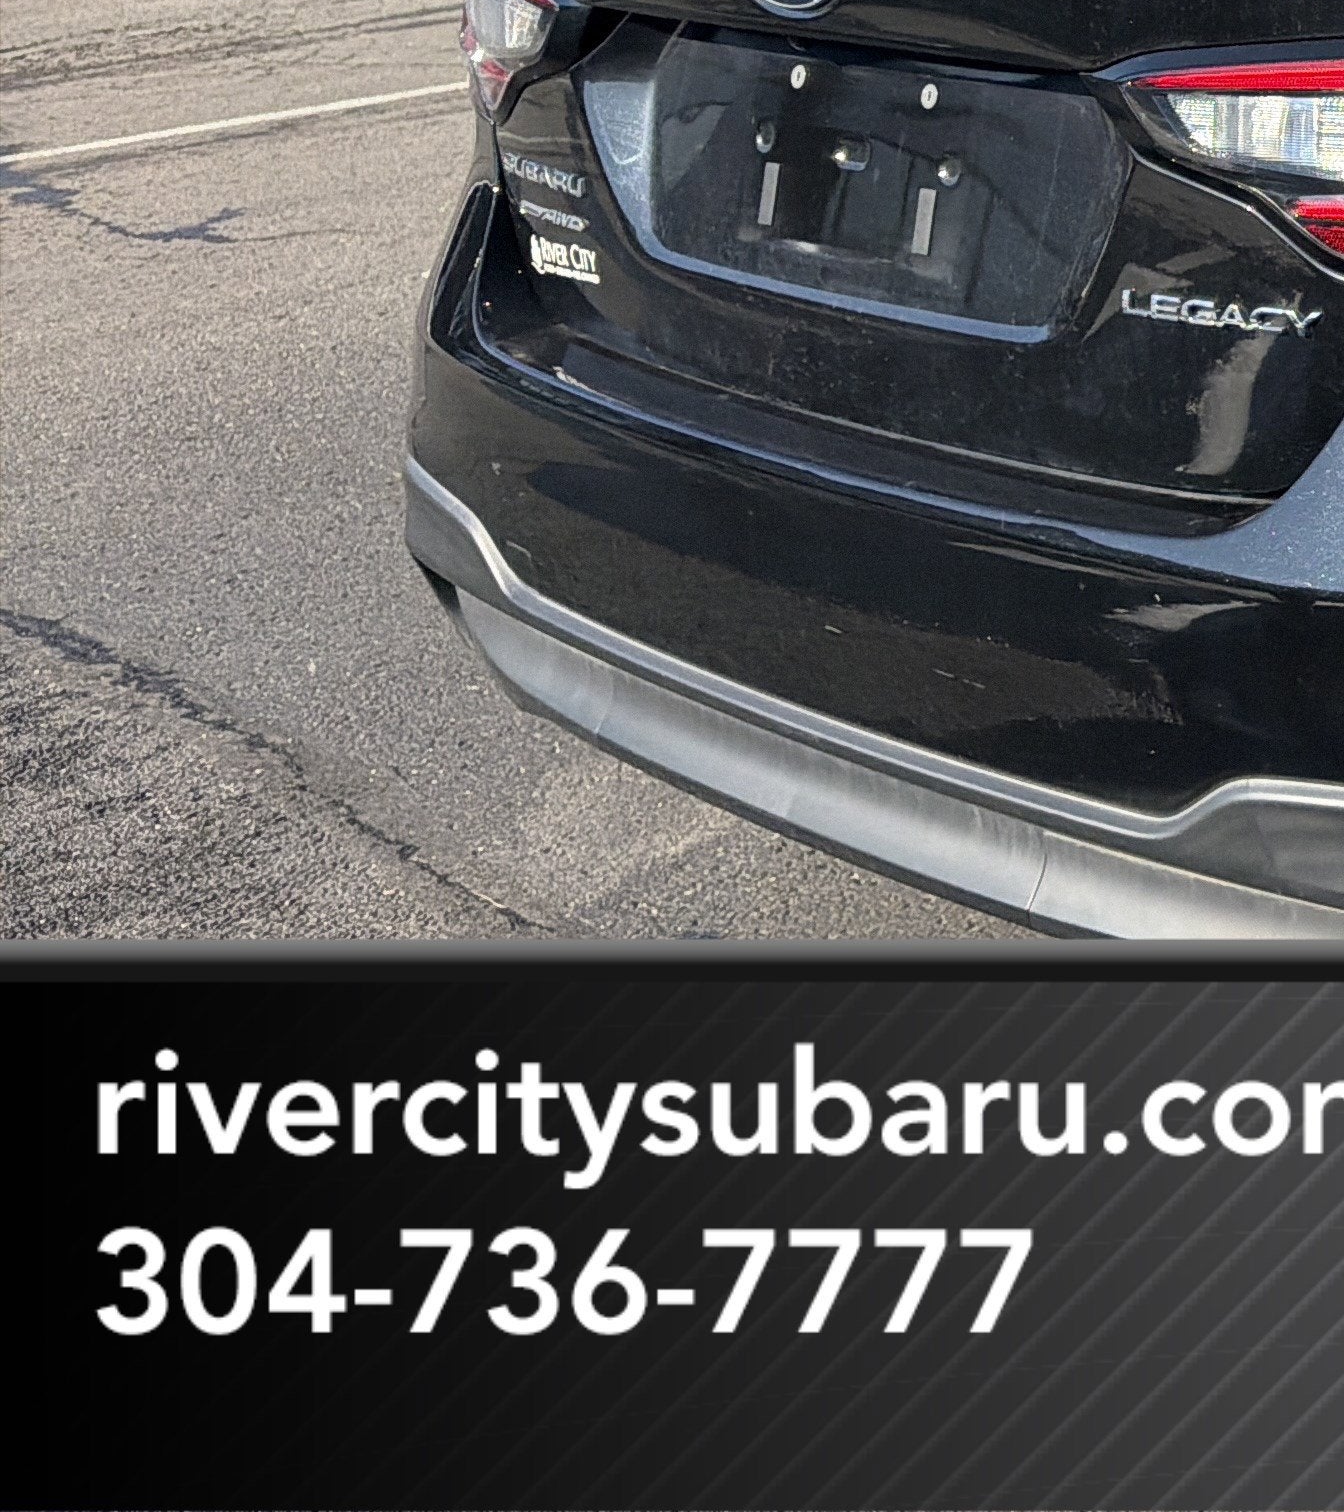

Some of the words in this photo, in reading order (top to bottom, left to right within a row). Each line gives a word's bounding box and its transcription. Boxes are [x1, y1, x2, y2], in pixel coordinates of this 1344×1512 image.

[502, 152, 586, 198] SUBARU
[539, 236, 569, 267] RIVER
[569, 243, 597, 273] CITY
[1121, 288, 1323, 337] LEGACY
